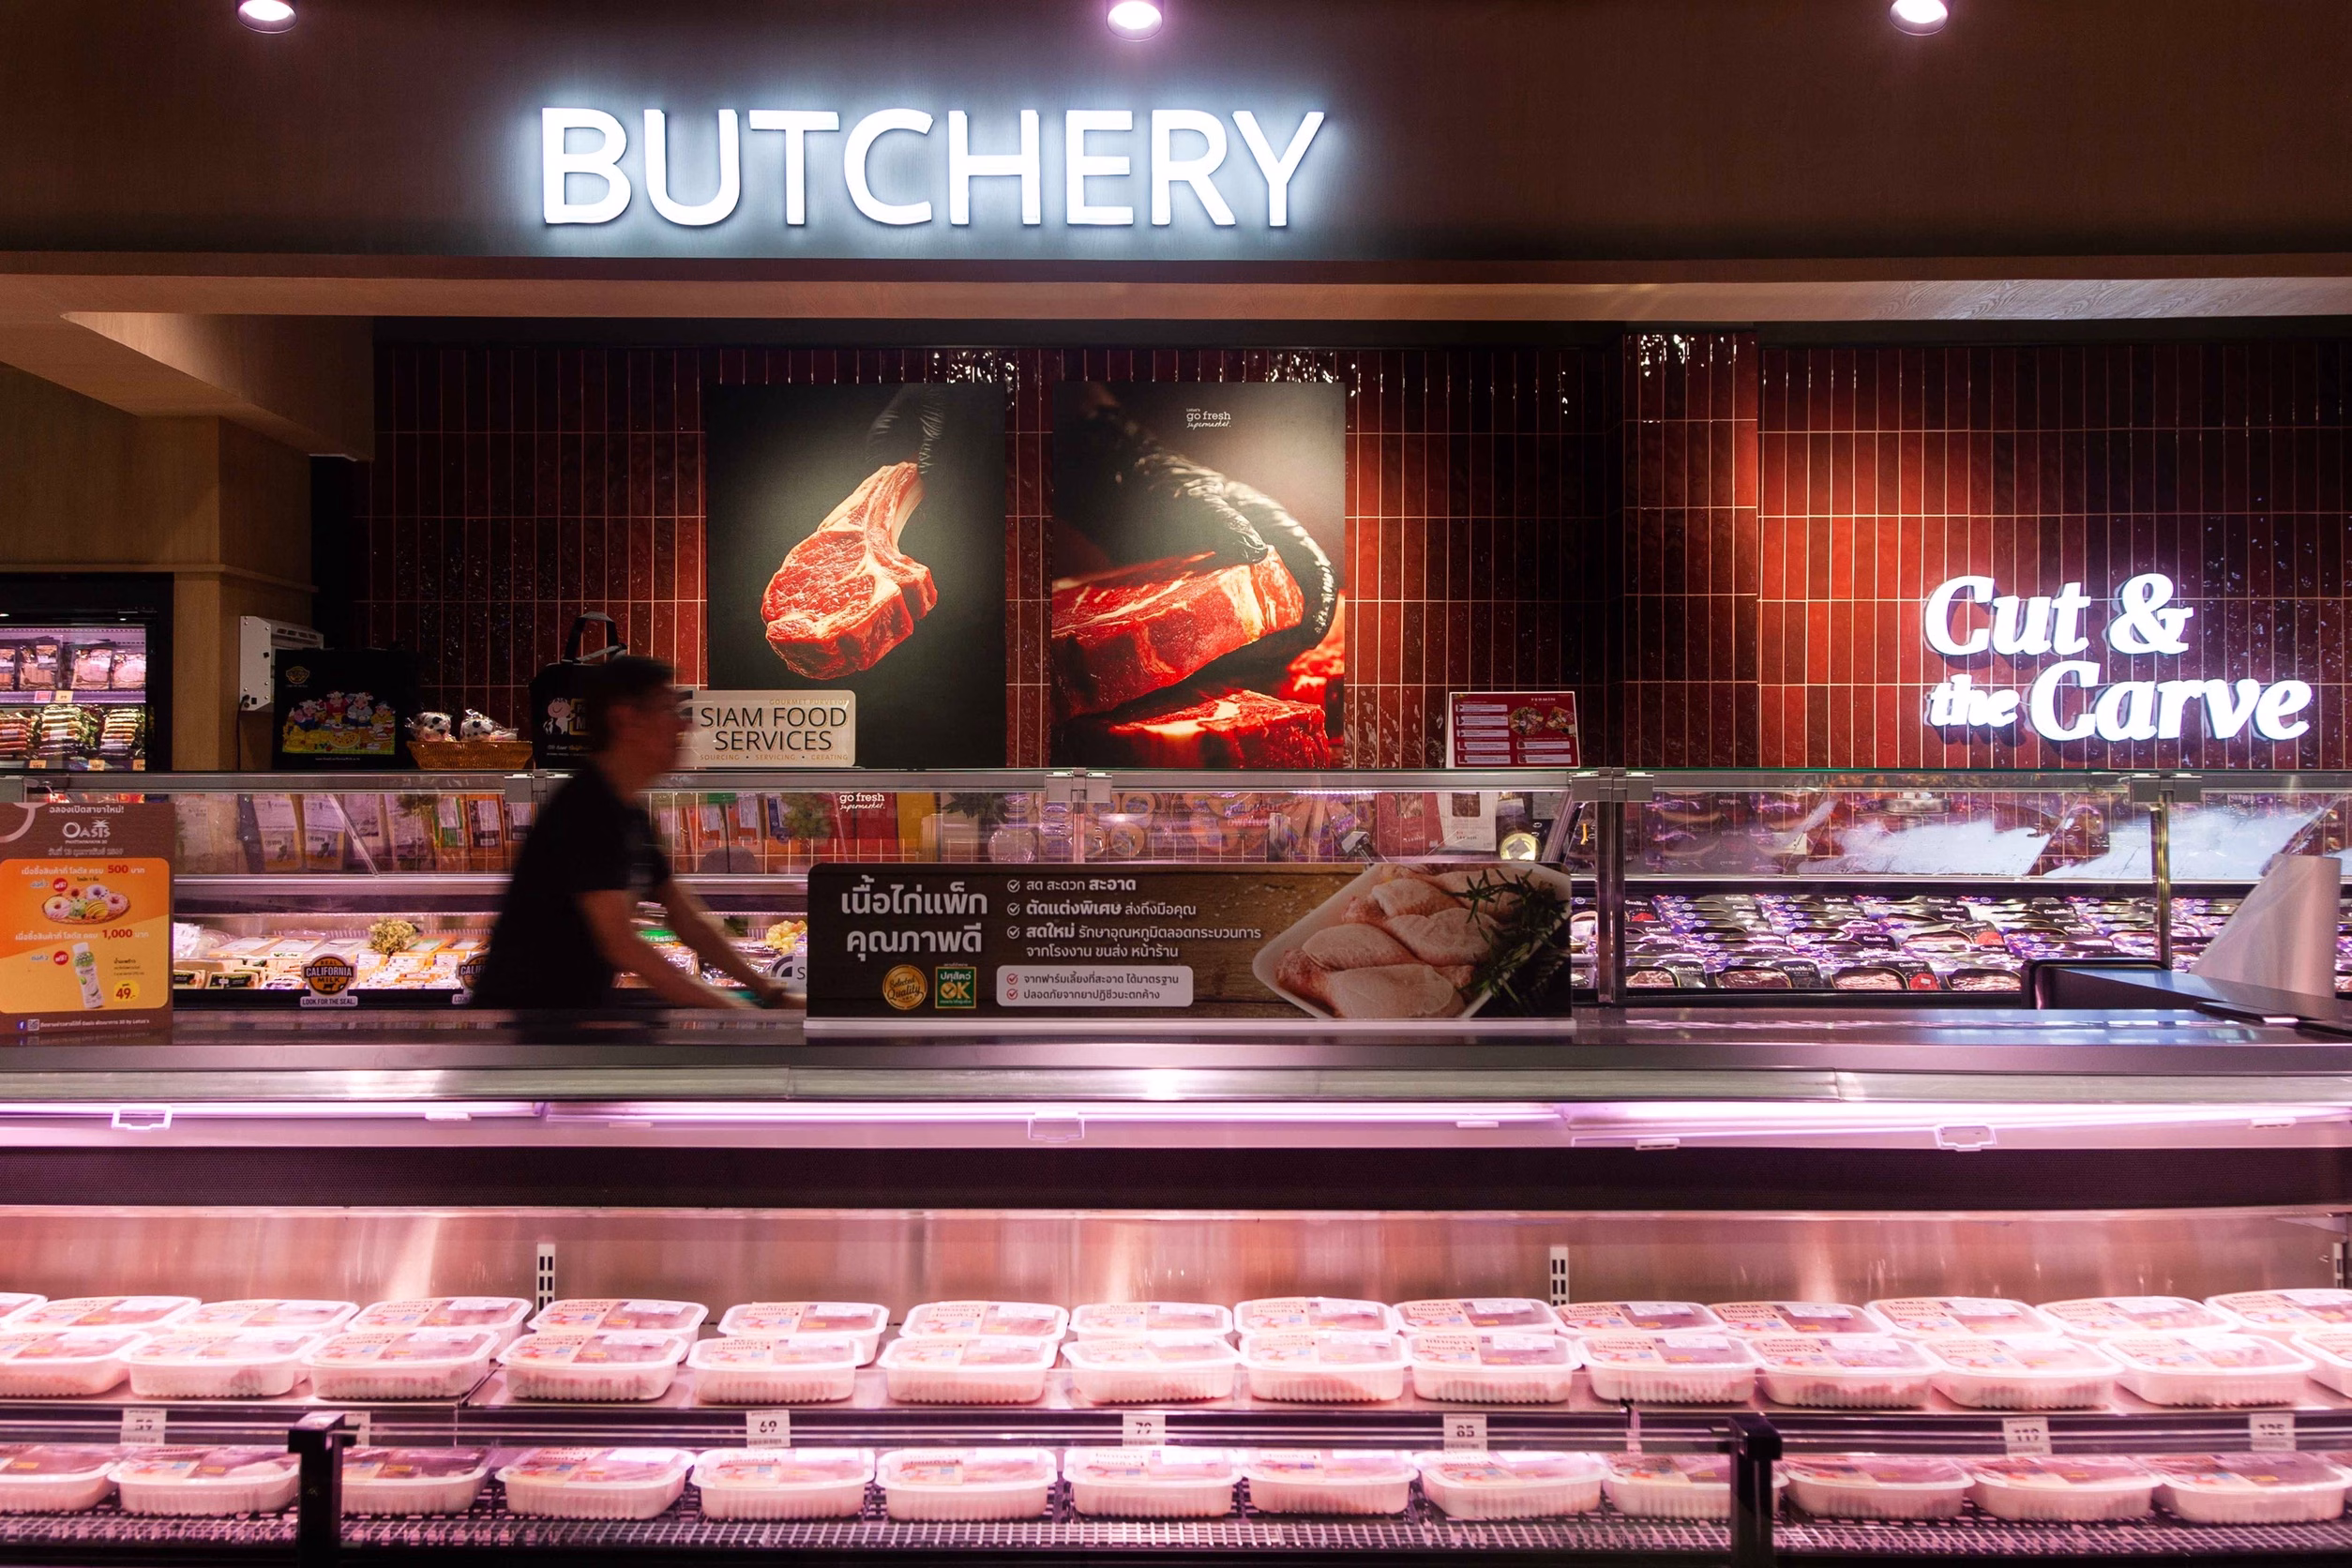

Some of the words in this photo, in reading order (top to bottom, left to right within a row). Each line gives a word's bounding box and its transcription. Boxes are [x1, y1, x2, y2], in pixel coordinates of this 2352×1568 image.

[542, 106, 1326, 228] BUTCHERY
[1185, 413, 1201, 422] go
[1203, 411, 1231, 420] fresh
[1925, 575, 2092, 656] Cut
[2108, 573, 2194, 656] &
[1927, 673, 2021, 728] the
[2028, 659, 2313, 742] Carve
[700, 707, 762, 728] SIAM
[773, 707, 848, 728] FOOD
[715, 731, 833, 752] SERVICES
[839, 793, 854, 804] go
[856, 792, 885, 802] fresh
[108, 865, 128, 874] 500
[1026, 881, 1044, 891] สด
[1047, 881, 1086, 891] สะดวก
[1089, 879, 1138, 892] สะอาด
[841, 874, 988, 914] เนื้อไก่แพ็ก
[1026, 899, 1123, 915] ตัดแต่งพิเศษ
[1124, 902, 1197, 919] ส่งถึงมือคุณ
[102, 928, 133, 940] 1,000
[1026, 923, 1076, 939] สดใหม่
[1078, 926, 1261, 942] รักษาอุณหภูมิตลอดกระบวนการ
[846, 922, 983, 962] คุณภาพดี
[1026, 943, 1093, 957] จากโรงงาน
[1095, 945, 1129, 957] ขนส่ง
[1131, 943, 1179, 957] หน้าร้าน
[306, 966, 353, 976] CALIFORNIA
[889, 975, 916, 988] Selected
[1023, 971, 1124, 985] จากฟาร์มเลี้ยงที่สะอาด
[1126, 972, 1180, 987] ได้มาตรฐาน
[887, 985, 924, 1001] Quality
[1023, 988, 1161, 1002] ปลอดภัยจากยาปฏิชีวนะตกค้าง
[134, 1419, 153, 1431] 59
[759, 1420, 777, 1433] 69
[1135, 1422, 1153, 1435] 79
